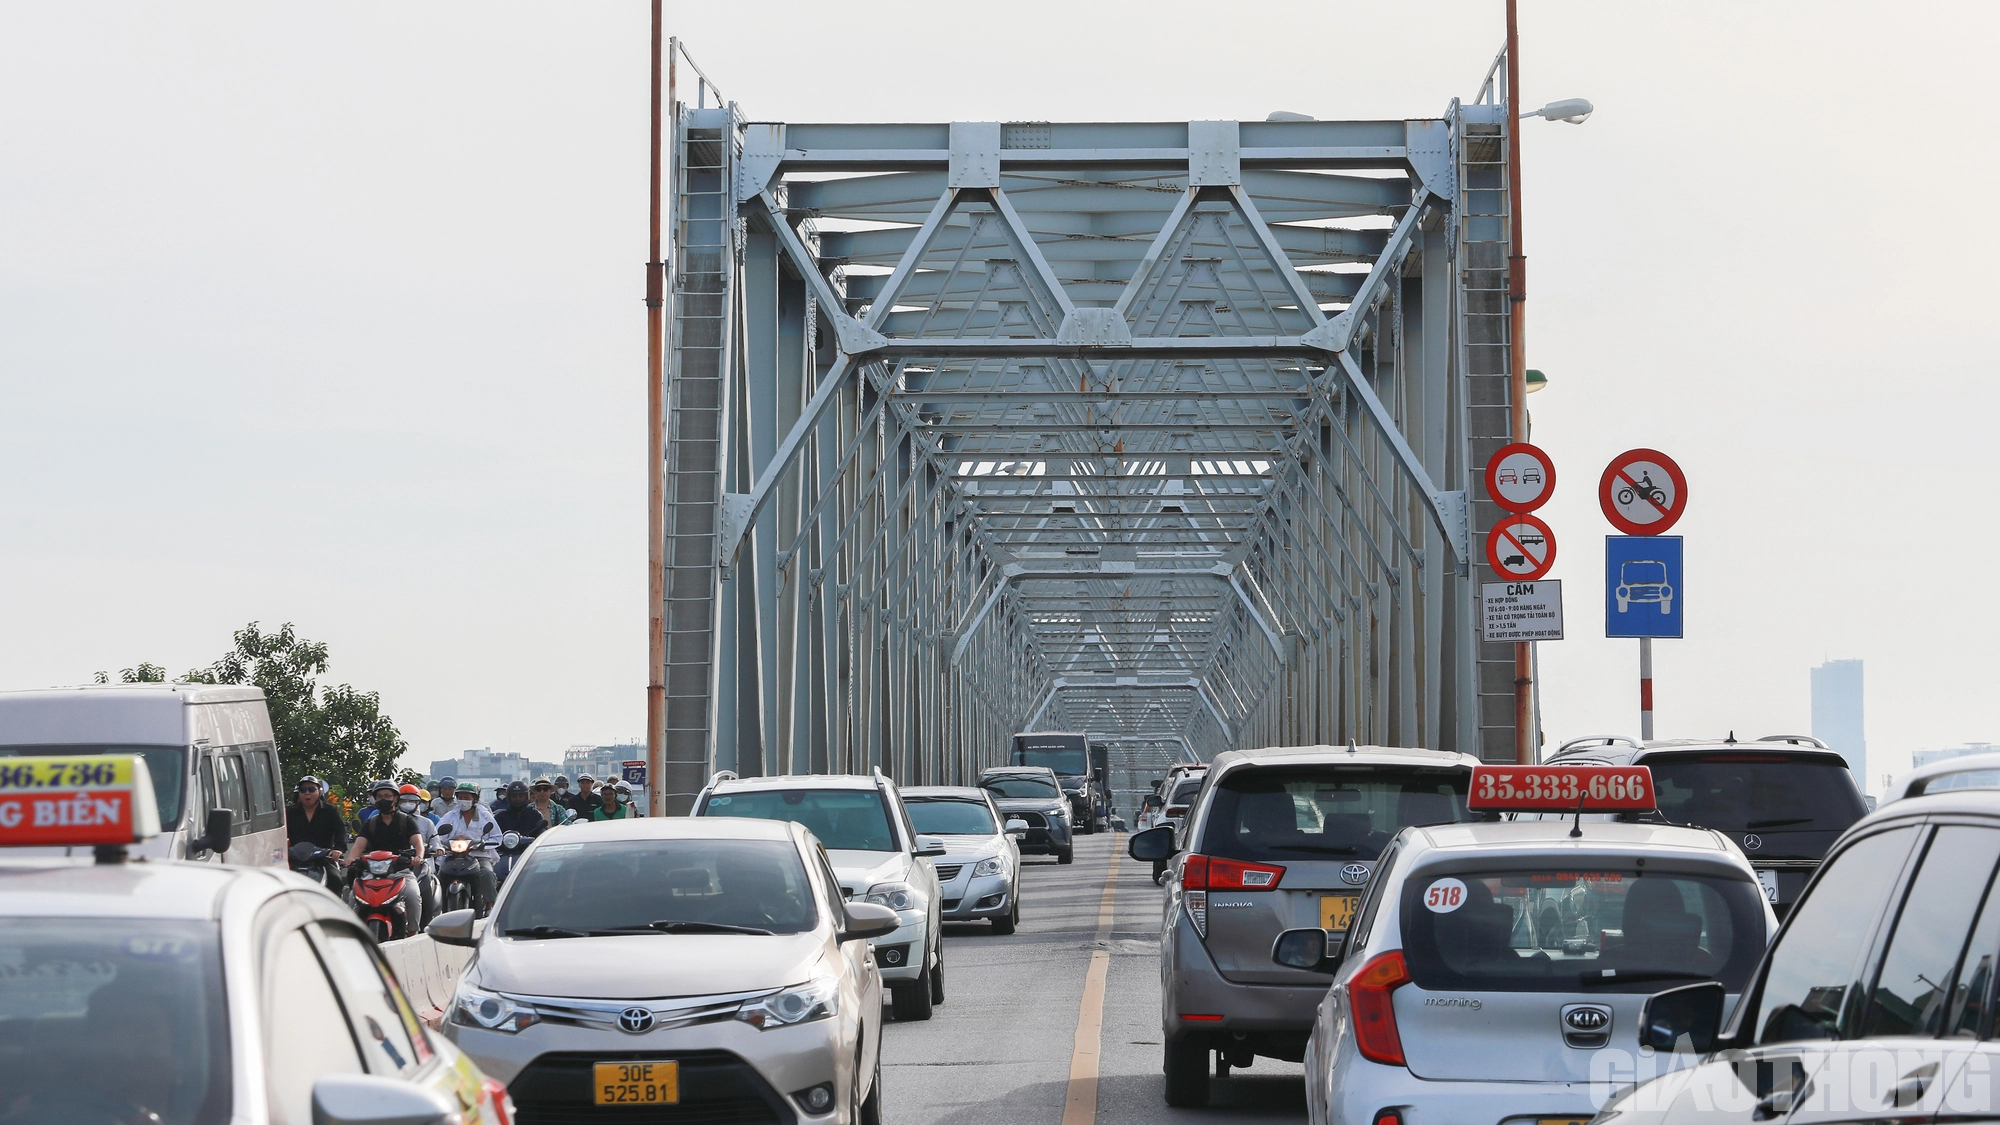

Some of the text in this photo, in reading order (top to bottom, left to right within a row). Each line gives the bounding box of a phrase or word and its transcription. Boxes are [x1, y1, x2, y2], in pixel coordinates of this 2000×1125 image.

[1507, 582, 1534, 595] CẤM
[1511, 613, 1526, 621] TRỌNG
[1549, 611, 1555, 619] BỘ
[1507, 621, 1516, 629] TẤN
[1535, 630, 1547, 638] HOẠT
[1478, 774, 1645, 800] 35.333.666
[33, 792, 122, 827] BIÊN
[1428, 886, 1461, 907] 518
[1424, 996, 1482, 1010] morning
[1573, 1011, 1602, 1026] KIA
[618, 1064, 654, 1082] 30E
[604, 1084, 667, 1102] 525.81
